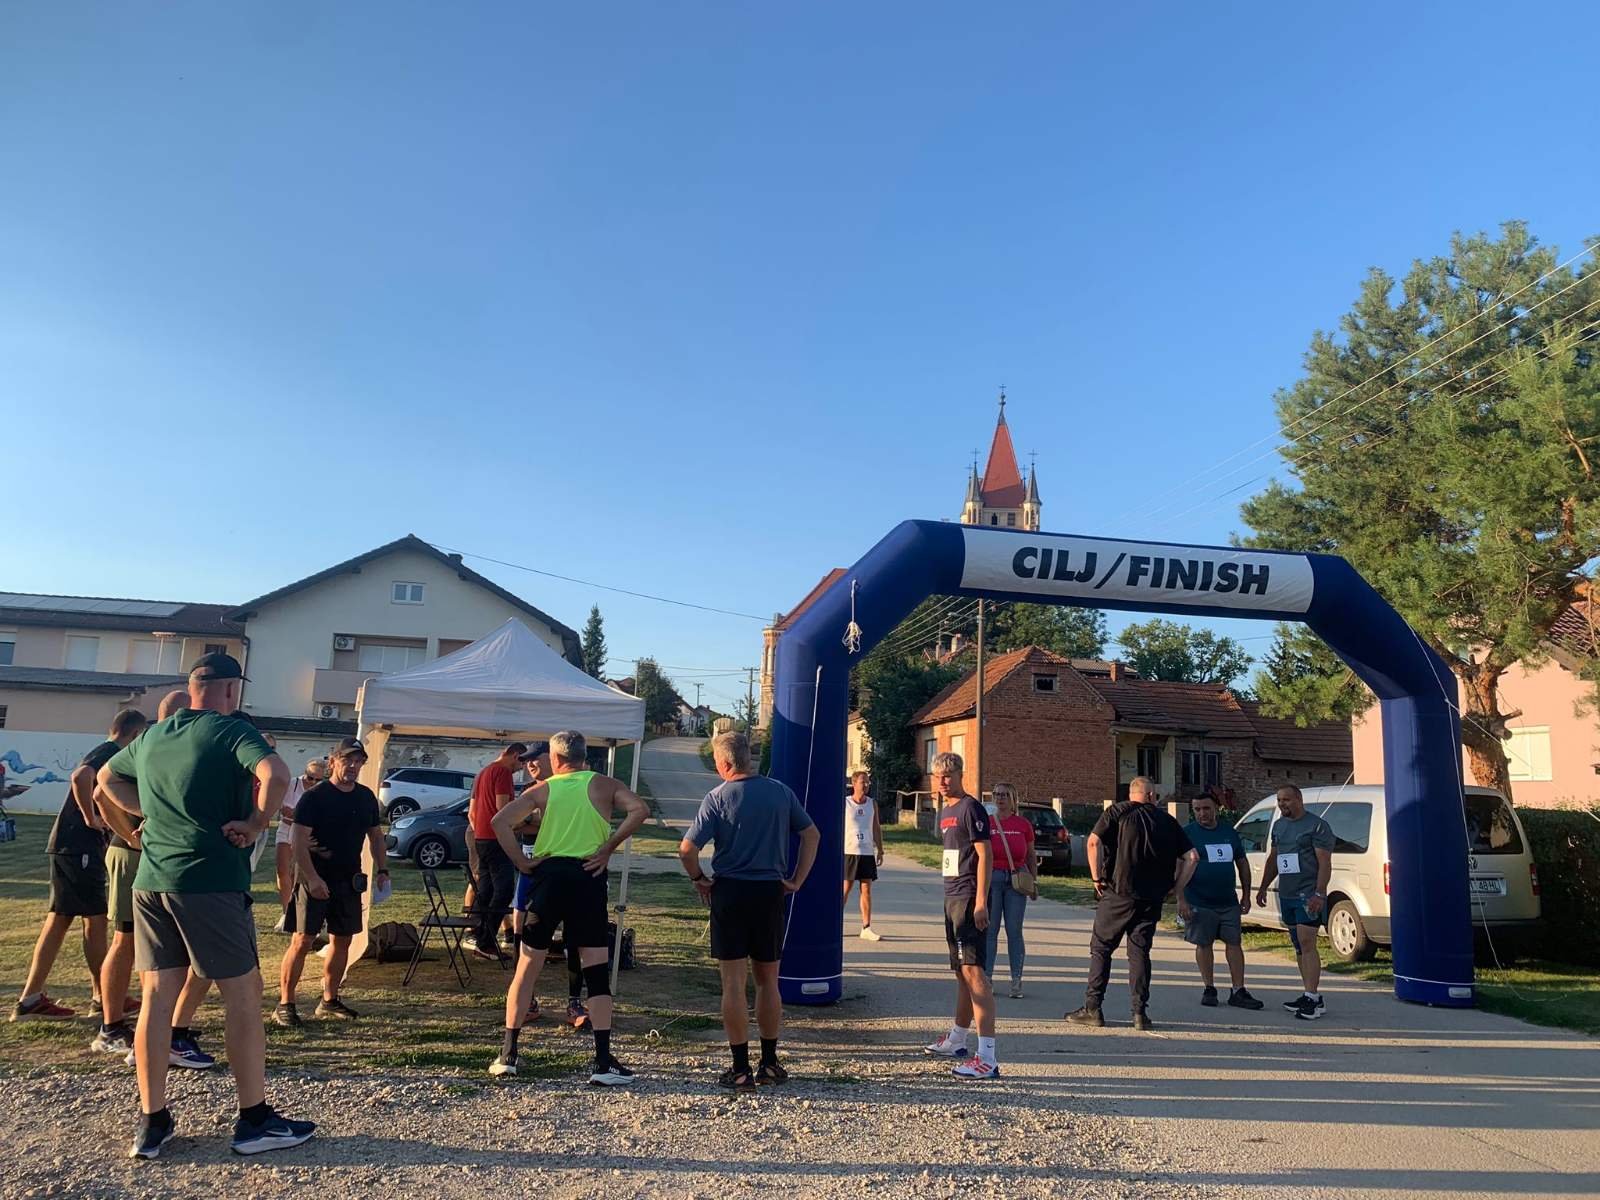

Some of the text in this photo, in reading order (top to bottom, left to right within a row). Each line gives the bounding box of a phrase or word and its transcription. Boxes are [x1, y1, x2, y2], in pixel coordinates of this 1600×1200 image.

[1012, 546, 1270, 596] CILJ/FINISH
[1217, 848, 1223, 857] 9
[1282, 859, 1288, 869] 3
